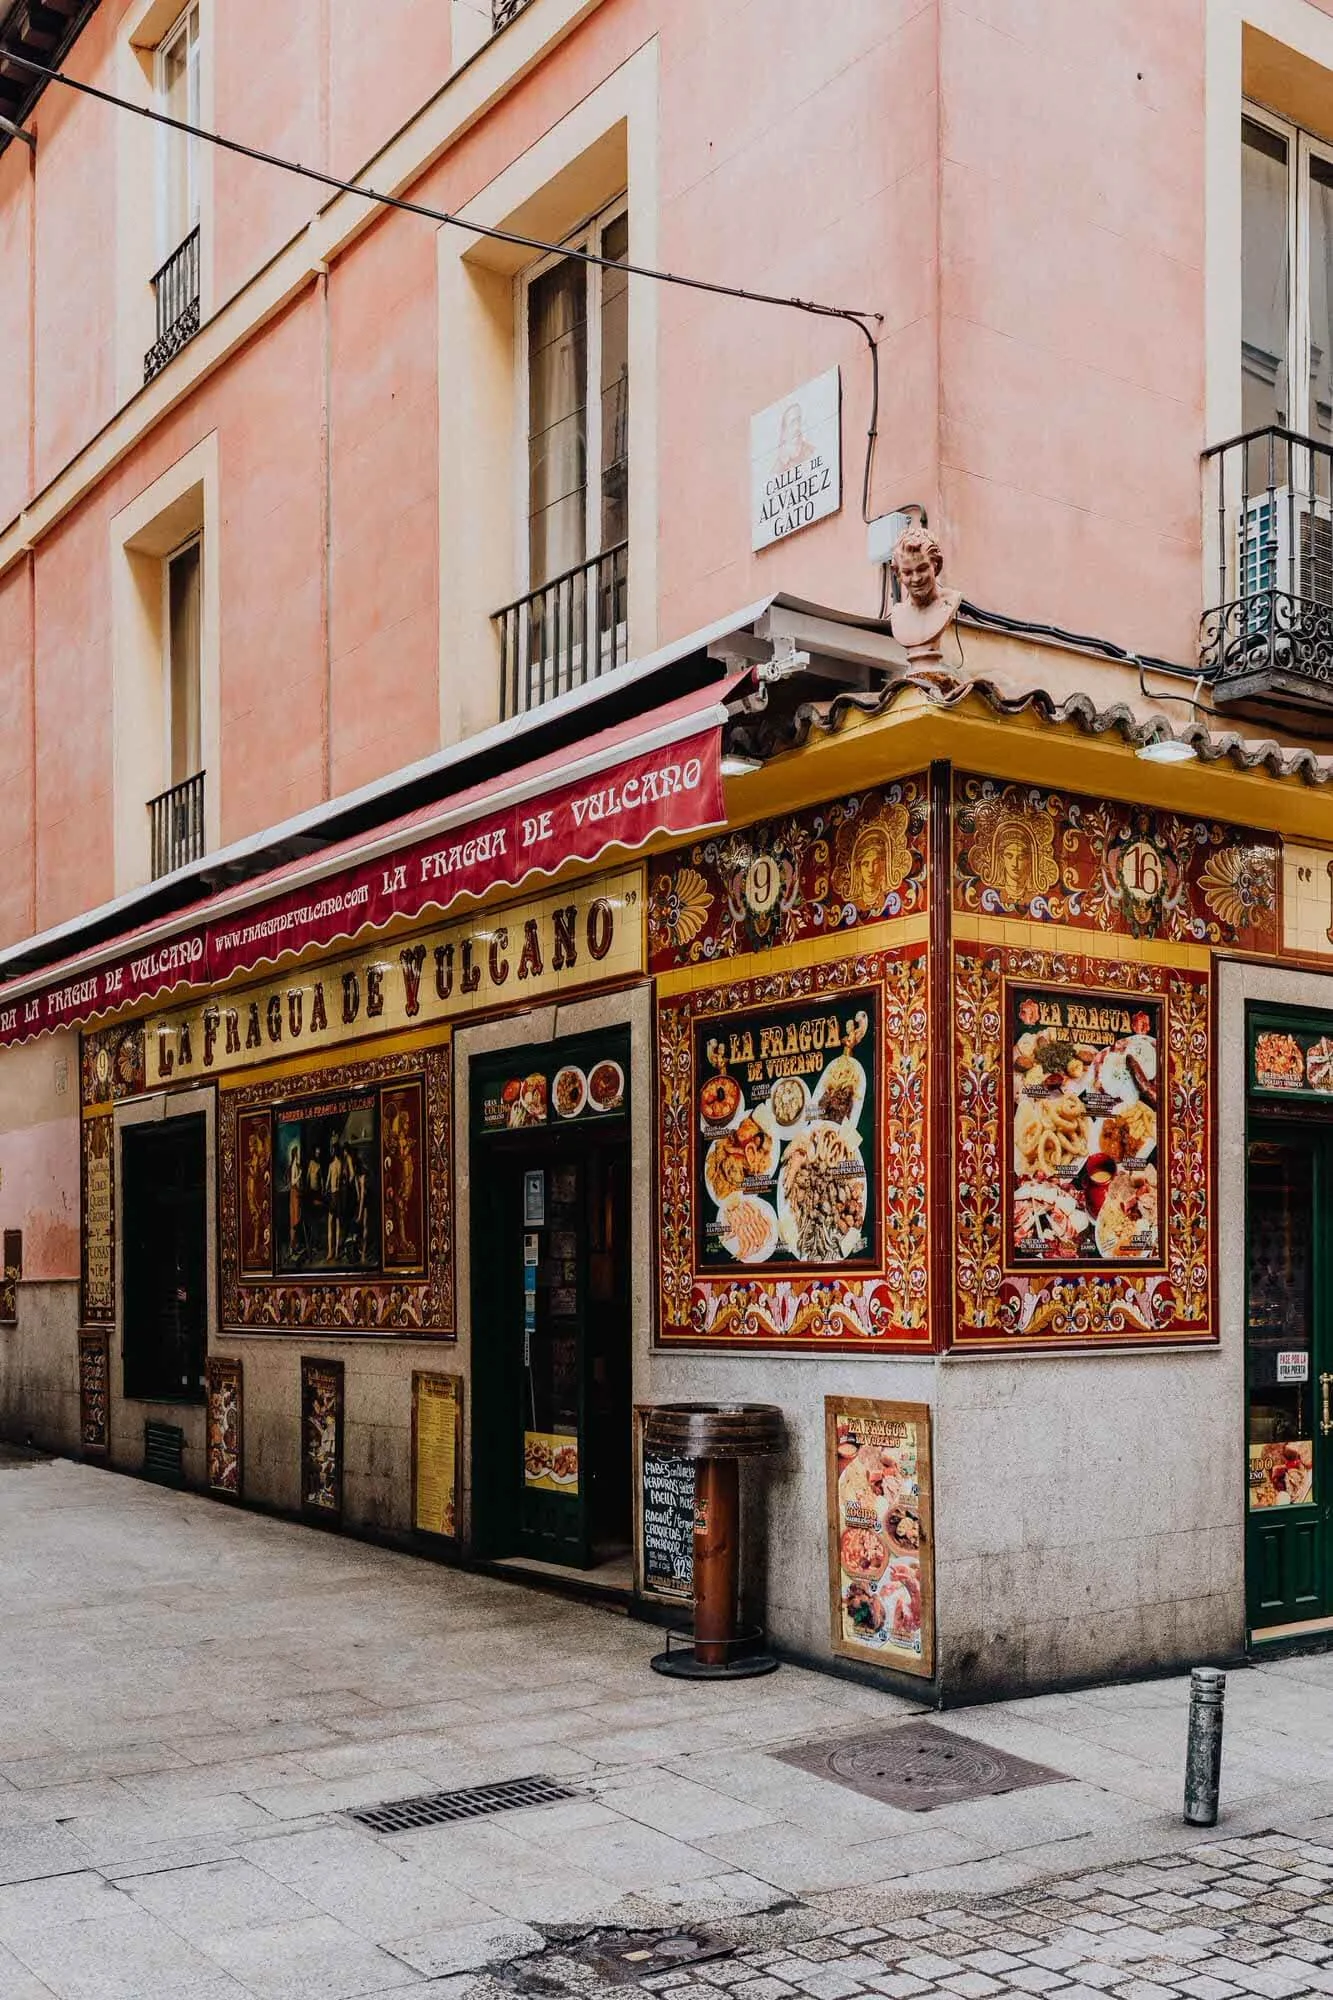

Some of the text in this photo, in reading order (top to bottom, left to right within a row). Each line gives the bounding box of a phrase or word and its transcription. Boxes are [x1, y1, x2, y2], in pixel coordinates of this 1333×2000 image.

[759, 468, 832, 523] ALVAREZ
[766, 455, 824, 496] CALLE DE
[774, 501, 815, 537] GATO
[382, 757, 702, 896] LA FRAGUA DE VULCANO
[753, 860, 772, 904] 9
[1126, 845, 1159, 894] 16
[24, 998, 40, 1023] LA
[47, 976, 98, 1015] FRAGUA
[105, 967, 124, 994] DE
[130, 937, 204, 983] VULCANO
[203, 981, 329, 1067] FRAGUA
[341, 965, 385, 1025] DE
[729, 1015, 841, 1064] LA FRAGUA
[1039, 1001, 1132, 1034] LA FRAGUA
[747, 1050, 824, 1082] DE VULCANO
